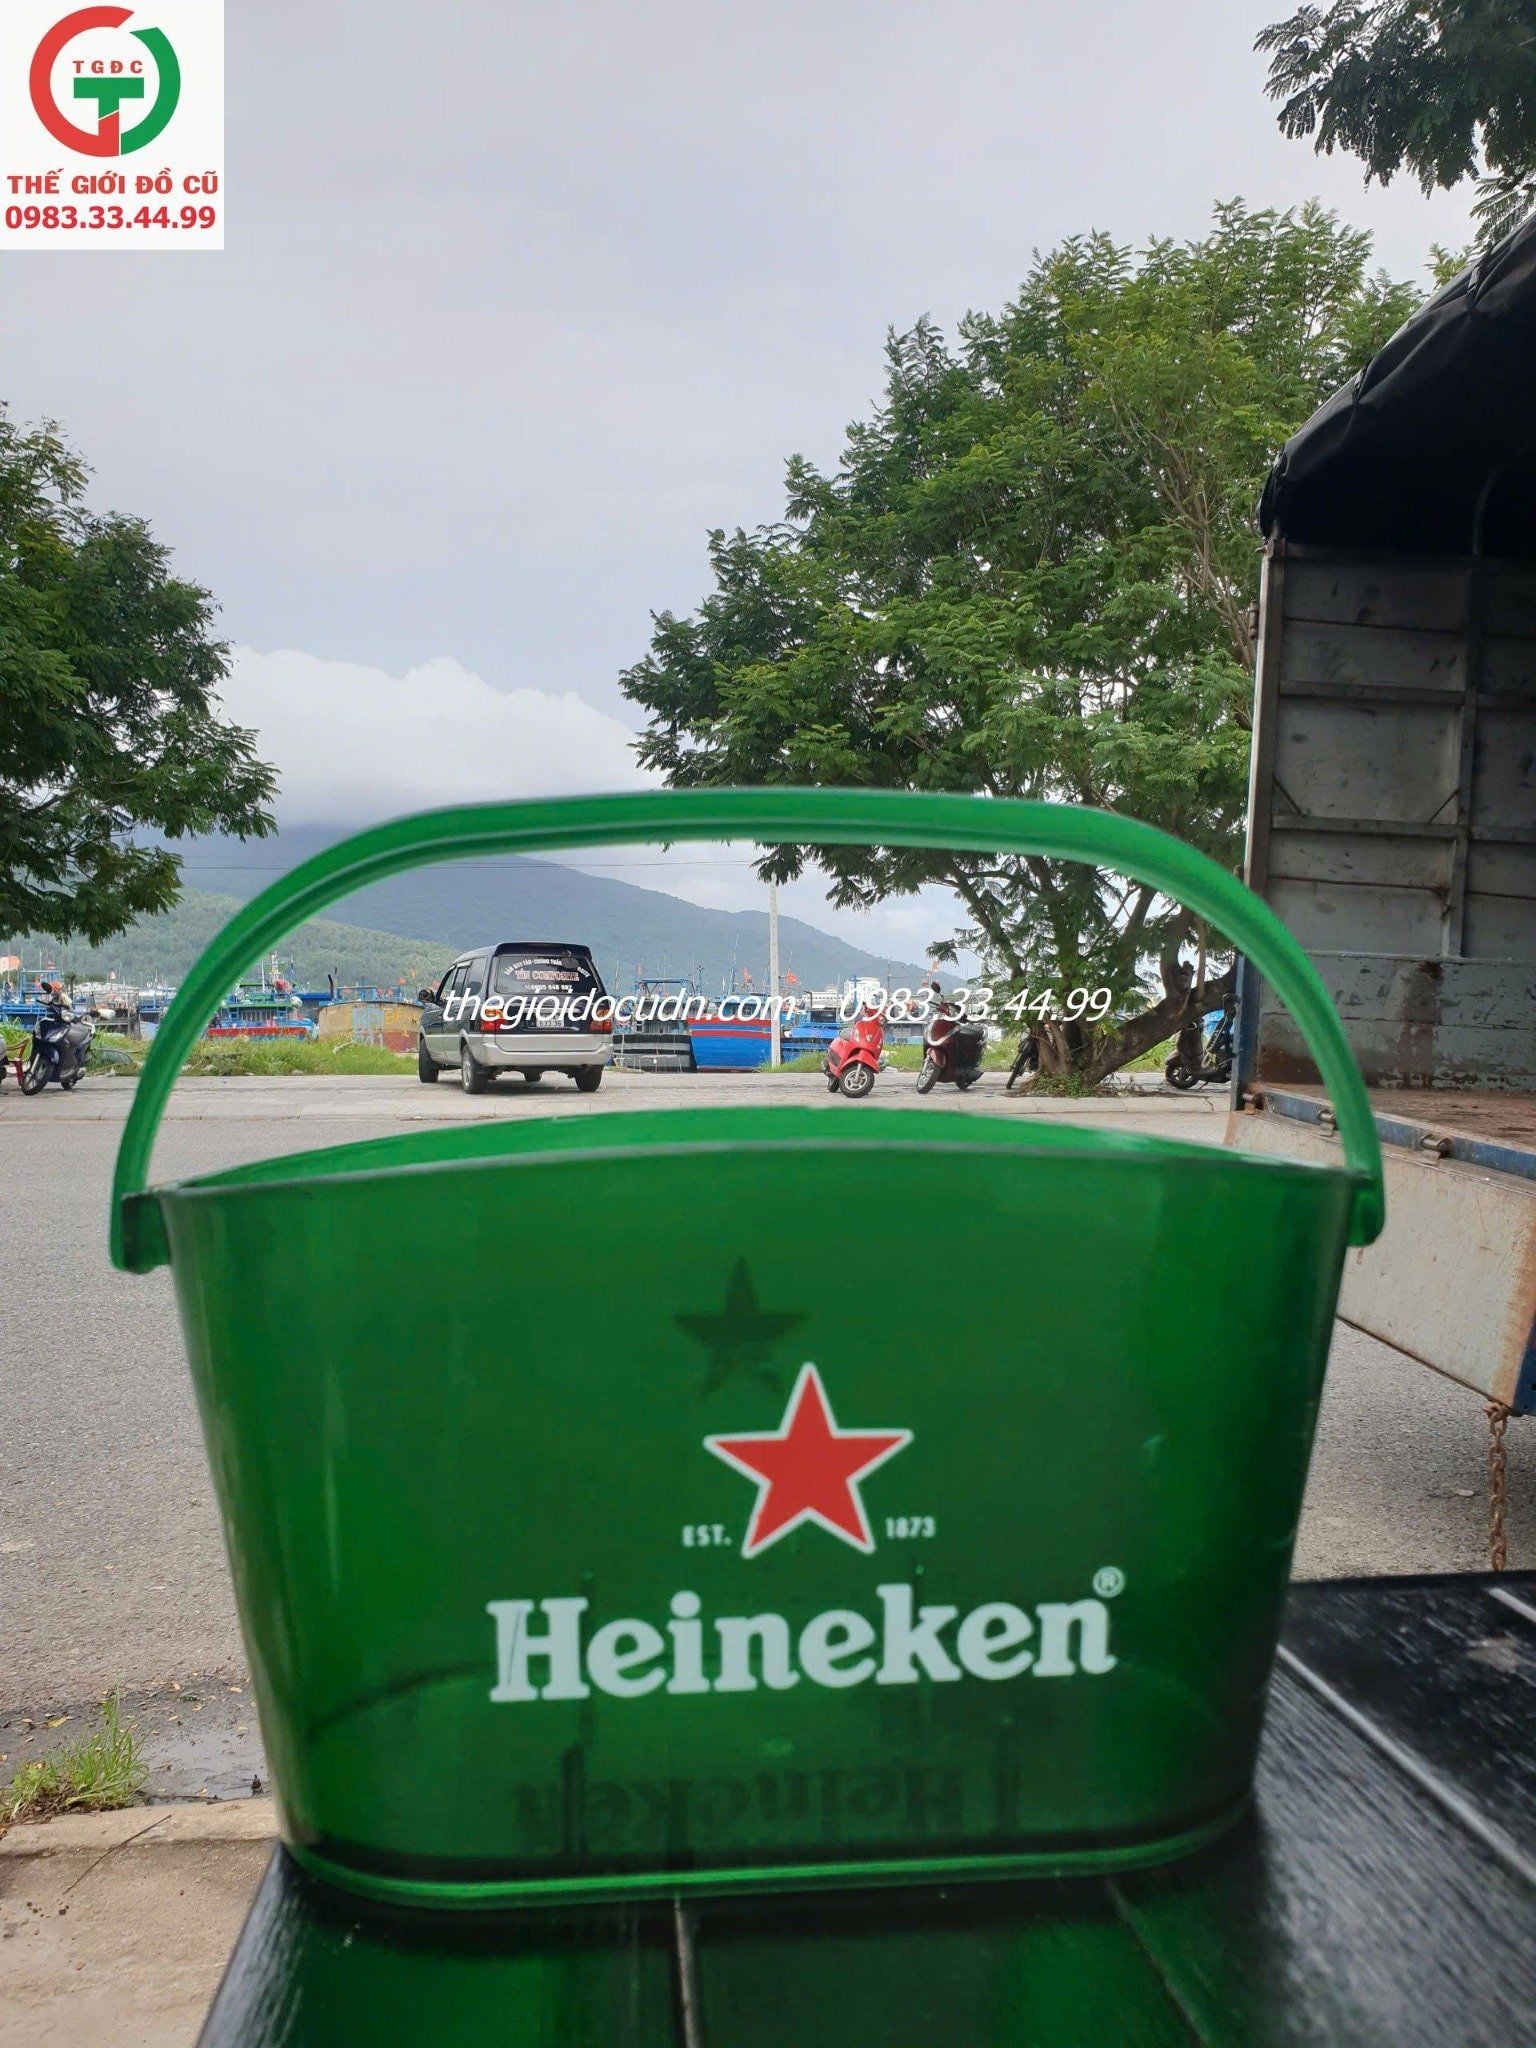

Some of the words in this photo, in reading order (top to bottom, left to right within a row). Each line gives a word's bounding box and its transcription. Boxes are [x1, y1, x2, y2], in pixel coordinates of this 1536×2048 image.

[682, 1523, 733, 1547] EST.
[885, 1516, 936, 1538] 1873
[485, 1583, 1119, 1703] Heineken
